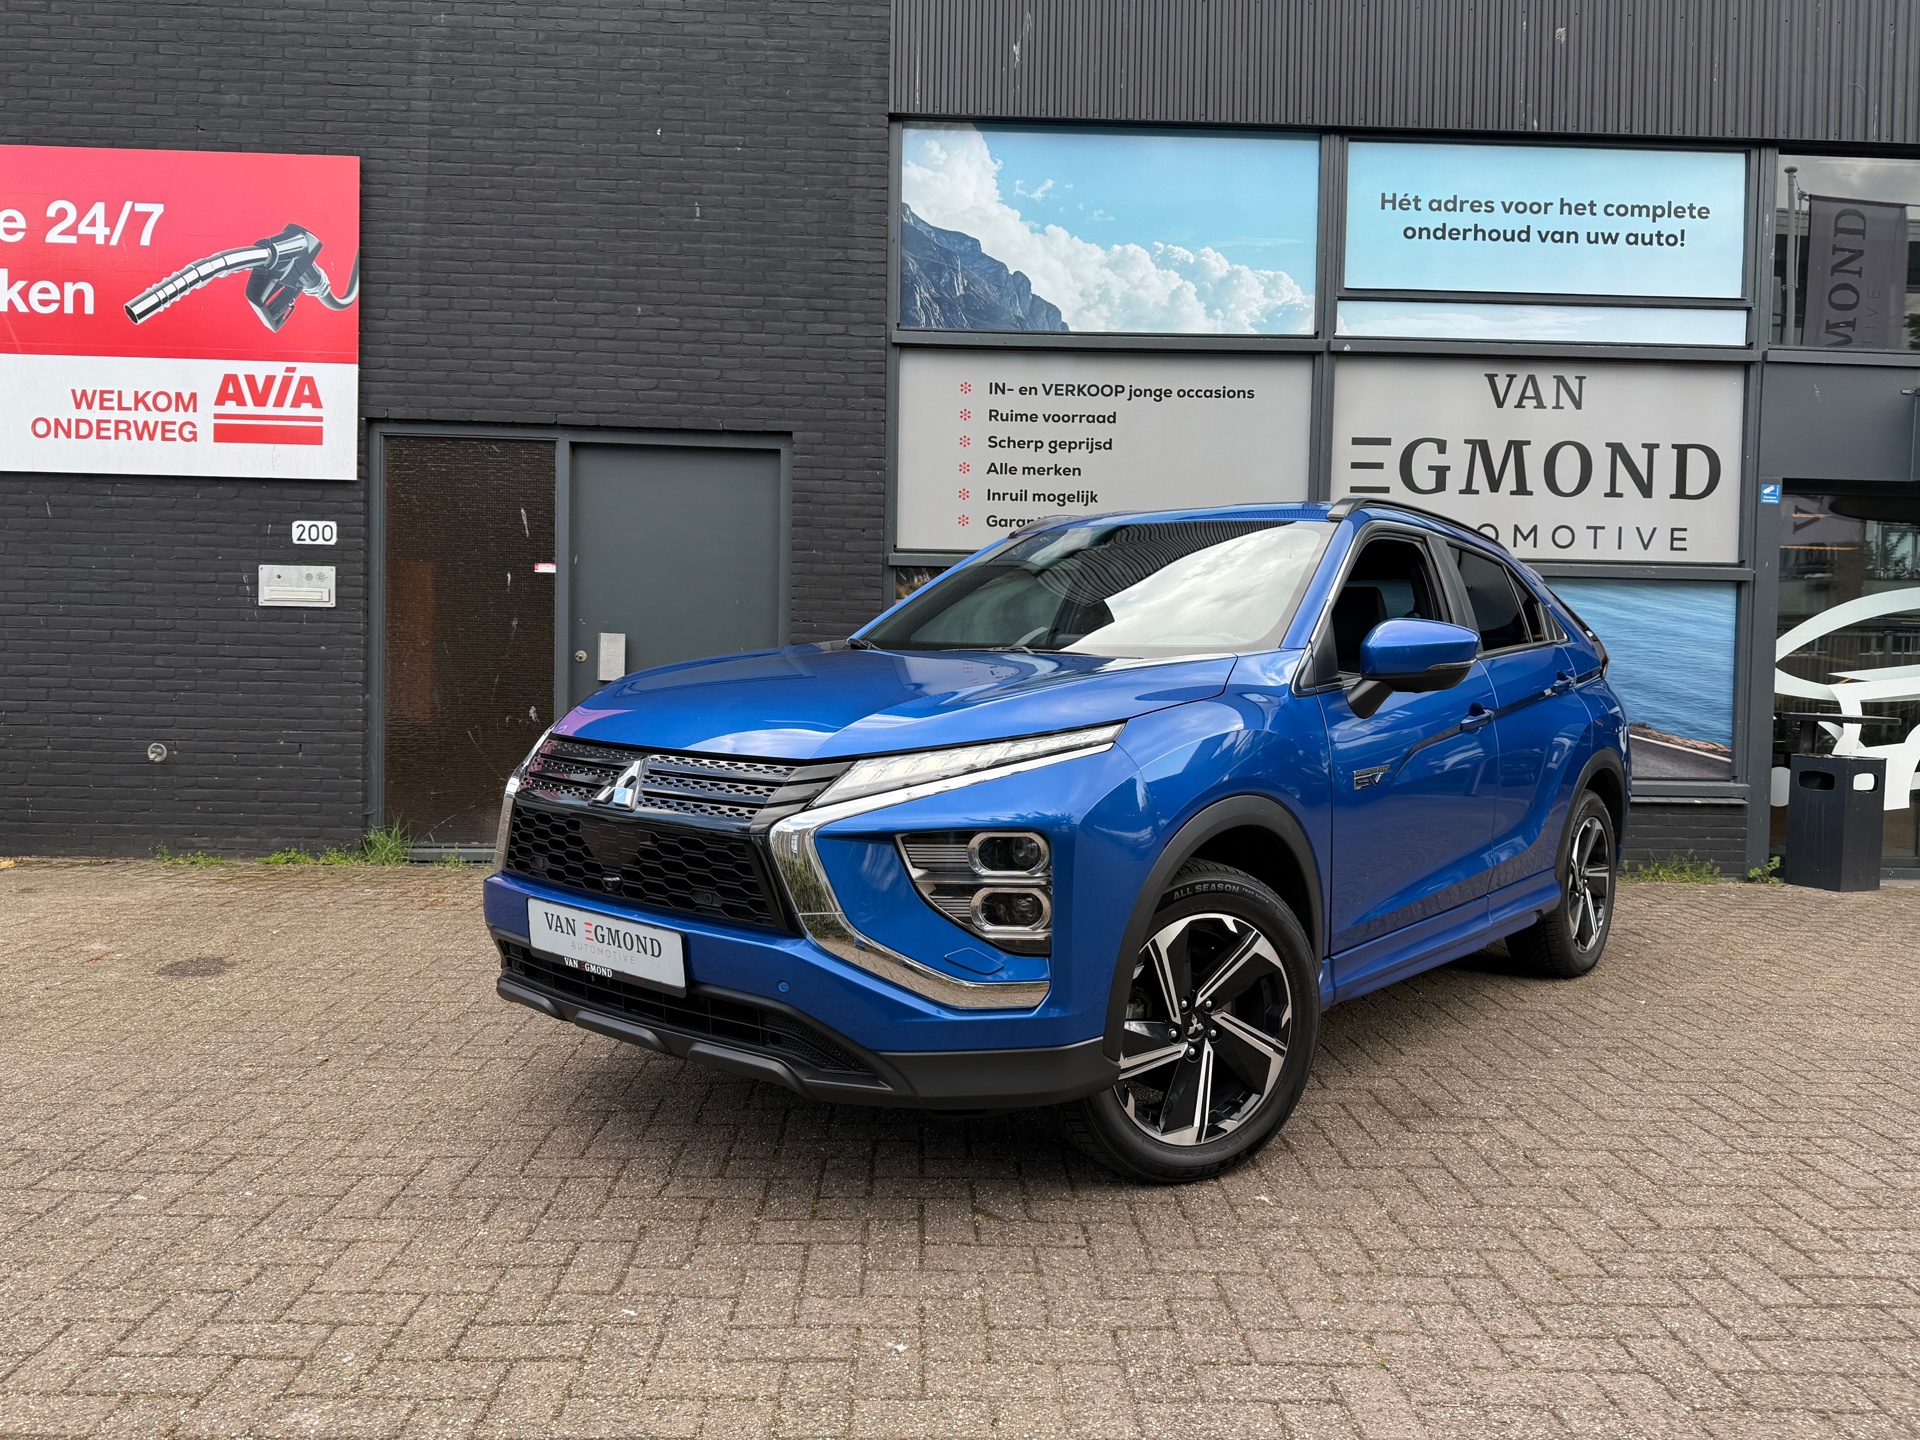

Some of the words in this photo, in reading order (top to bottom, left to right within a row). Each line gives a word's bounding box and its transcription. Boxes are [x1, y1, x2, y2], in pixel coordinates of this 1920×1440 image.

[1381, 193, 1421, 211] Hét
[1429, 195, 1494, 213] adres
[1501, 201, 1553, 214] voor
[1560, 198, 1597, 216] het
[1604, 201, 1710, 223] complete
[45, 200, 164, 245] 24/7
[1403, 223, 1530, 242] onderhoud
[1537, 230, 1578, 243] van
[1587, 232, 1619, 244] uw
[1626, 230, 1685, 247] auto!
[71, 389, 197, 412] WELKOM
[990, 382, 1014, 395] IN-
[1019, 387, 1037, 395] en
[1042, 384, 1125, 397] VERKOOP
[1127, 385, 1172, 402] jonge
[1177, 386, 1254, 398] occasions
[1484, 373, 1586, 410] VAN
[989, 409, 1038, 422] Ruime
[1042, 412, 1116, 423] voorraad
[31, 417, 197, 442] ONDERWEG
[988, 436, 1044, 452] Scherp
[1049, 438, 1112, 454] geprijsd
[987, 463, 1017, 475] Alle
[1022, 464, 1081, 476] merken
[1349, 437, 1721, 500] EGMOND
[988, 489, 1027, 501] Inruil
[1033, 491, 1098, 506] mogelijk
[297, 524, 333, 541] 200
[1173, 887, 1192, 900] ALL
[1195, 883, 1240, 893] SEASON
[544, 911, 576, 937] VAN
[584, 921, 662, 958] EGMOND
[571, 940, 635, 965] AUTOMOTIVE
[564, 956, 579, 969] VAN
[581, 961, 613, 978] EGMOND
